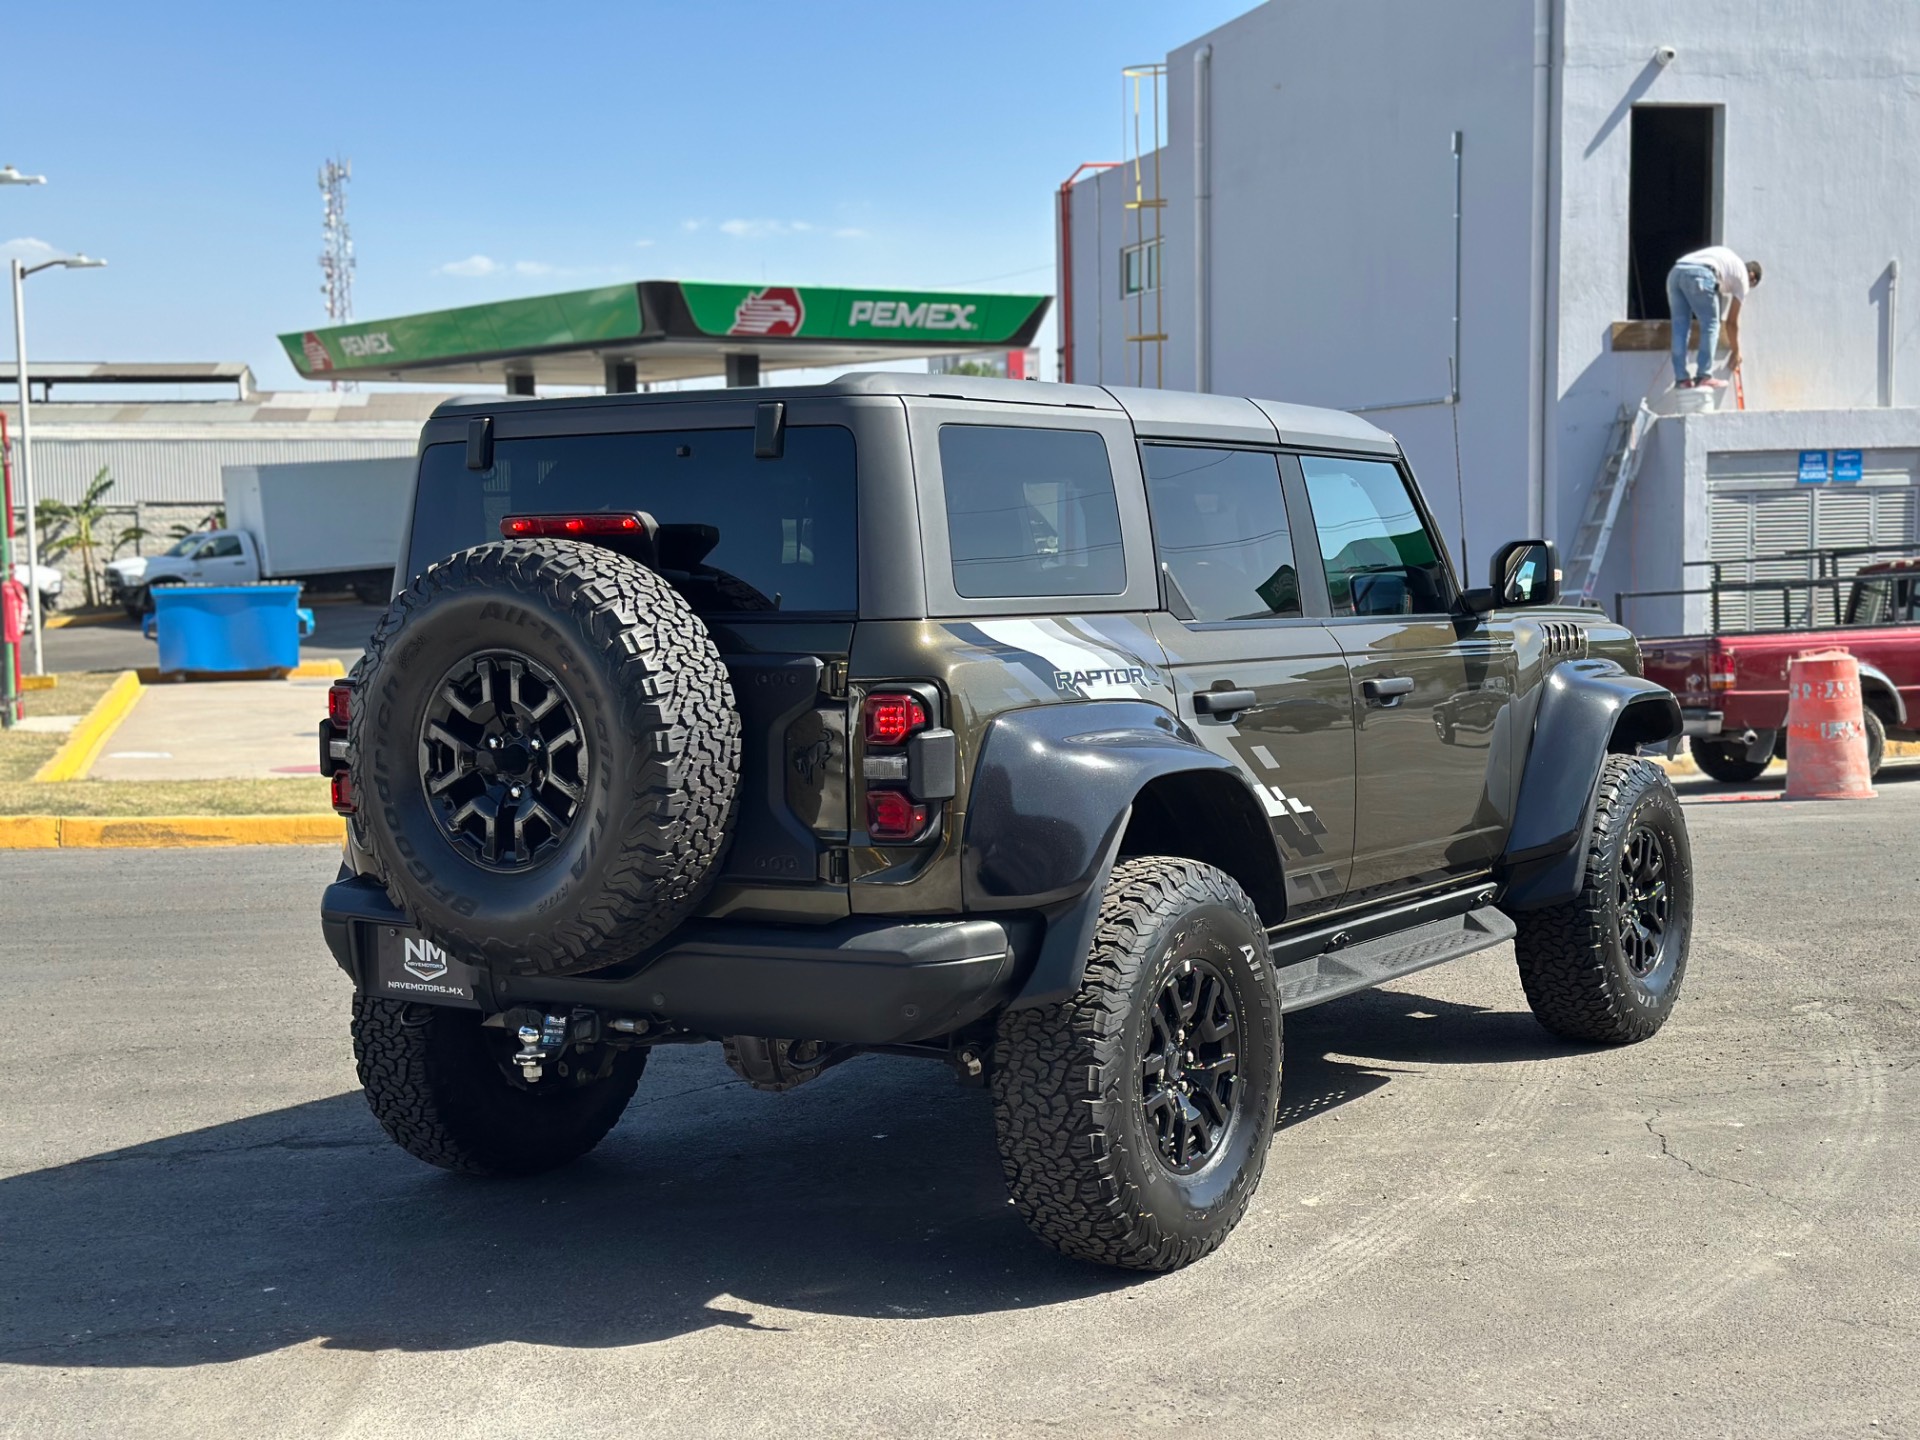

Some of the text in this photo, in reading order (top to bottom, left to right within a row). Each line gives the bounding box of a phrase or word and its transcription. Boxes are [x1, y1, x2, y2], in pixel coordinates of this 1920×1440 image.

[848, 300, 977, 330] PEMEX
[339, 332, 395, 357] PEMEX
[1054, 666, 1151, 697] RAPTOR
[404, 937, 446, 966] NM
[407, 961, 444, 970] NAVEMOTORS
[387, 980, 464, 996] NAVEMOTORS.MX
